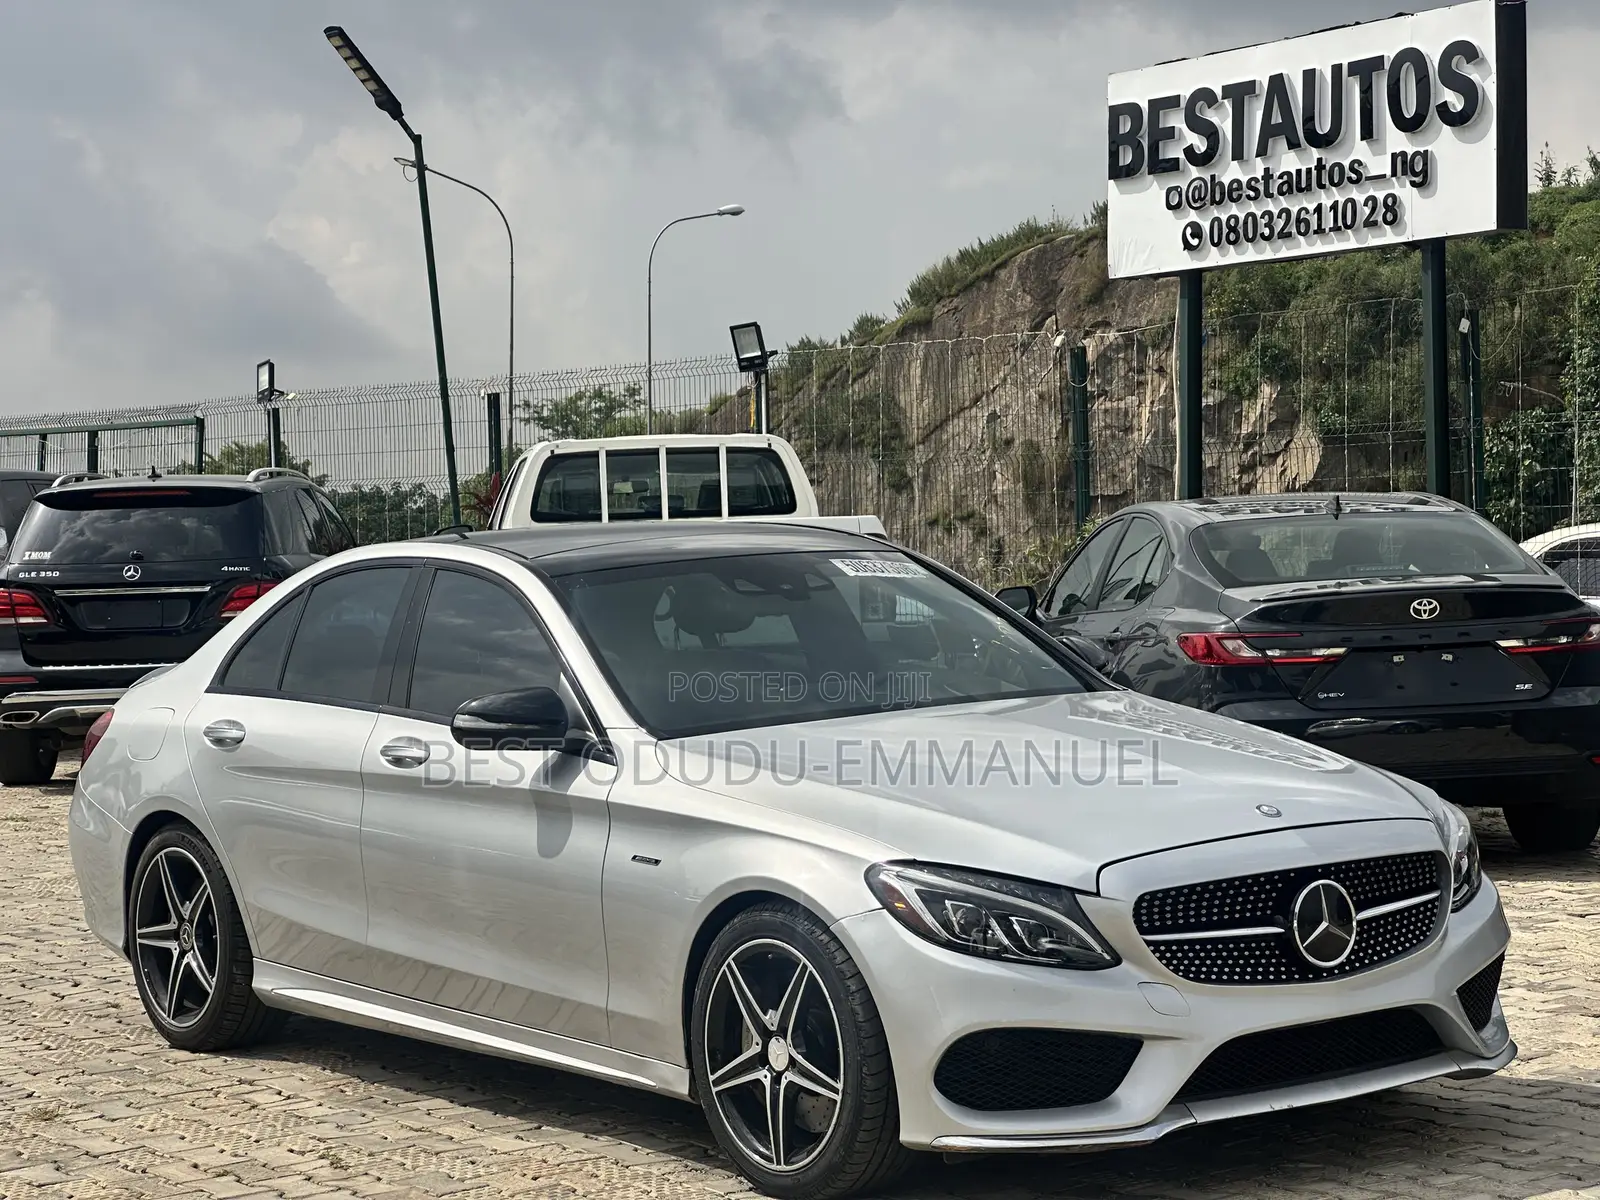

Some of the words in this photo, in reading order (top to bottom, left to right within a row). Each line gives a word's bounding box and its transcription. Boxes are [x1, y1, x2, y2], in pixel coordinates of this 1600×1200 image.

[1108, 38, 1480, 181] BESTAUTOS
[1185, 148, 1430, 211] @bestautos_ng
[1514, 683, 1534, 691] SE
